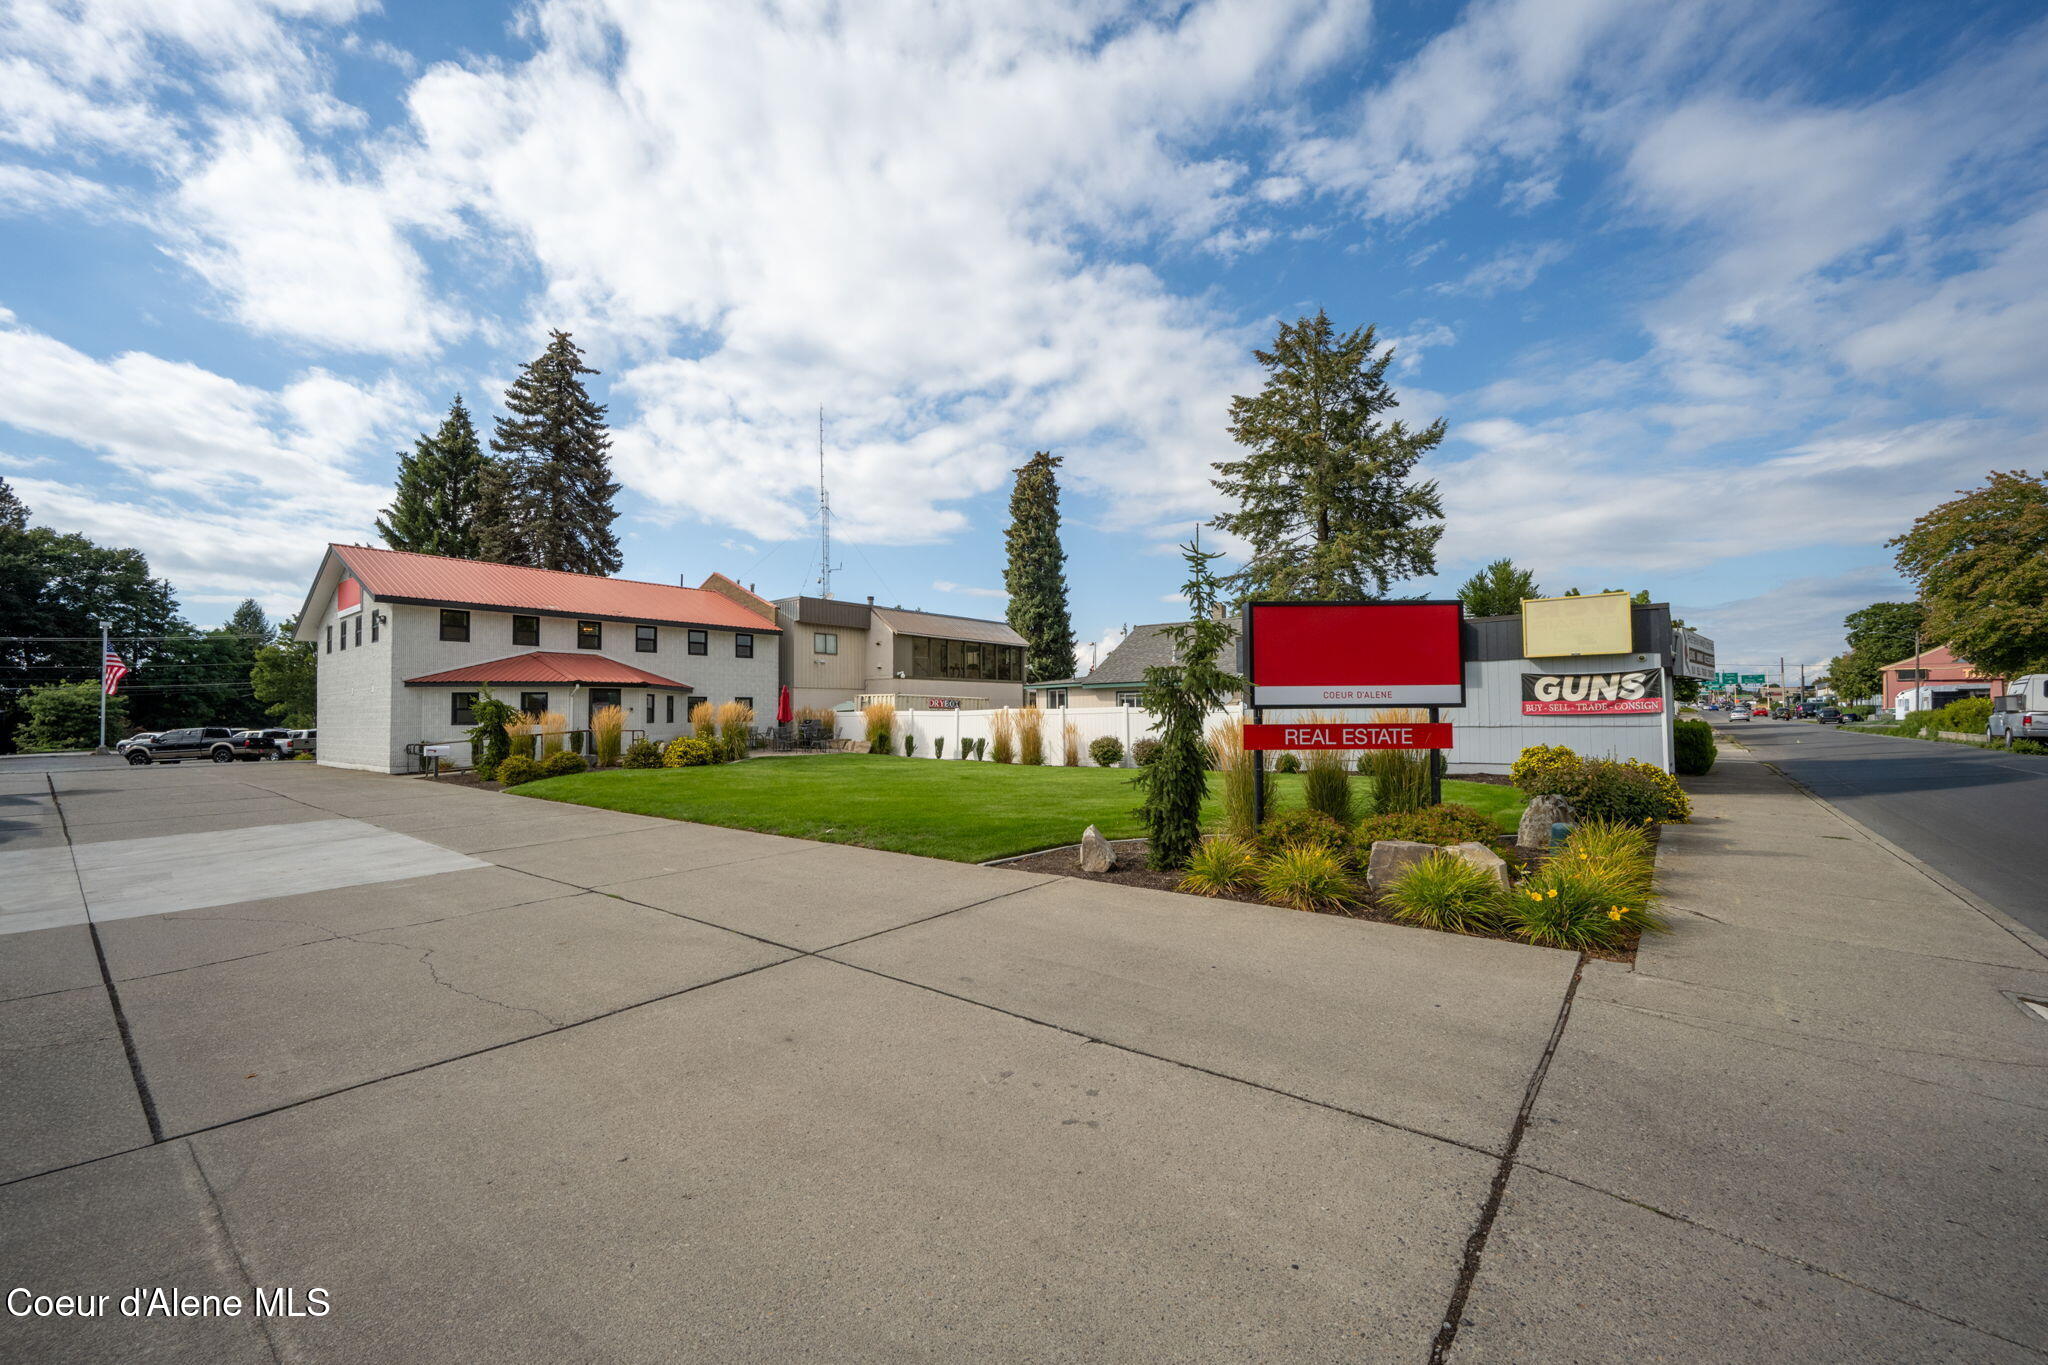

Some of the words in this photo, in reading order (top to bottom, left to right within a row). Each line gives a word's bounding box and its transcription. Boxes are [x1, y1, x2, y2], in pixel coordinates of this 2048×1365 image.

[1534, 672, 1647, 702] GUNS
[1323, 691, 1353, 699] COEUR
[1357, 690, 1393, 699] D'ALENE
[1525, 704, 1543, 712] BUY
[1548, 703, 1570, 712] SELL
[1576, 703, 1608, 711] TRADE
[1614, 702, 1659, 711] CONSIGN
[1284, 729, 1337, 745] REAL
[1342, 728, 1413, 745] ESTATE
